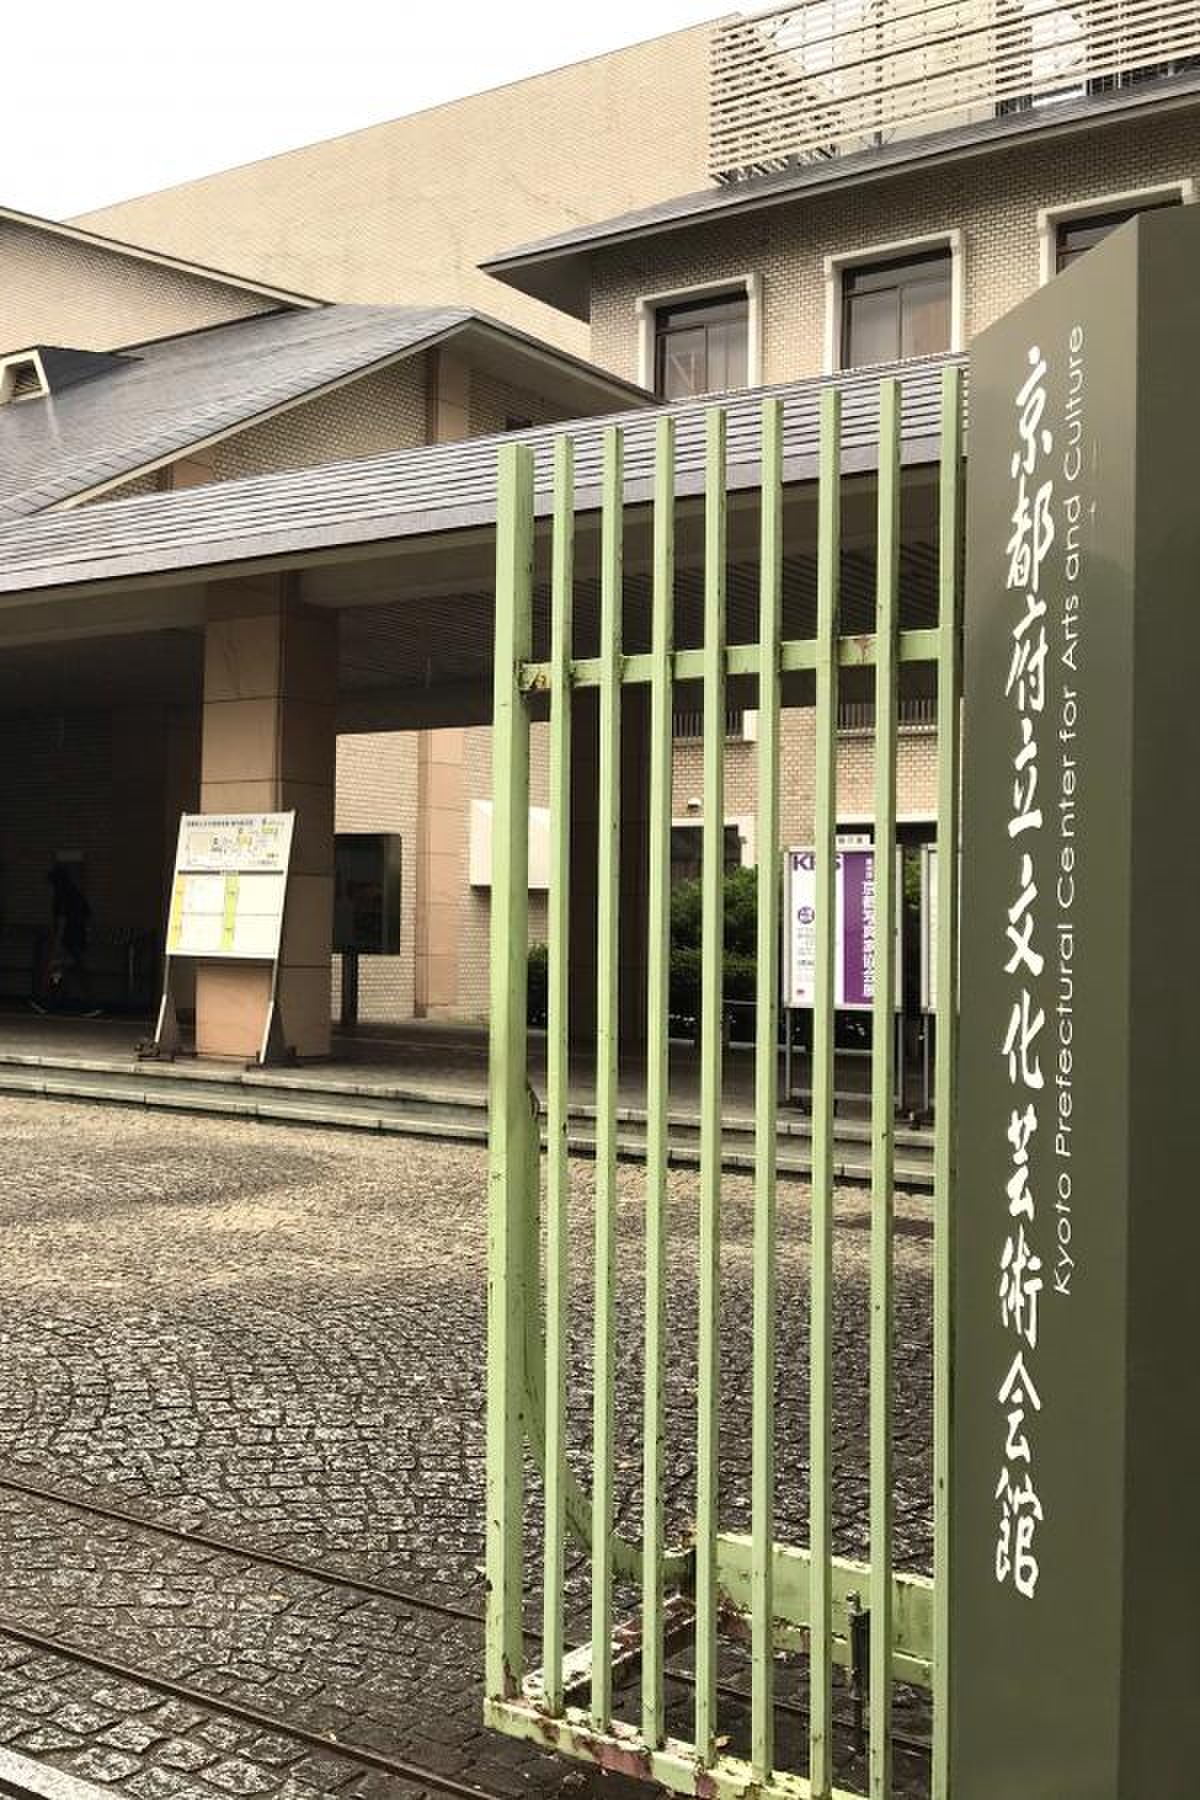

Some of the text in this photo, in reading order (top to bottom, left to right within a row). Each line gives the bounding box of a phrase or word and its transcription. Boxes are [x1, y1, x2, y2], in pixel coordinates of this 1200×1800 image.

[995, 345, 1053, 1600] 京都府立文化芸術会館
[1053, 325, 1084, 1296] Kyoto Prefectural Center for Arts and Culture
